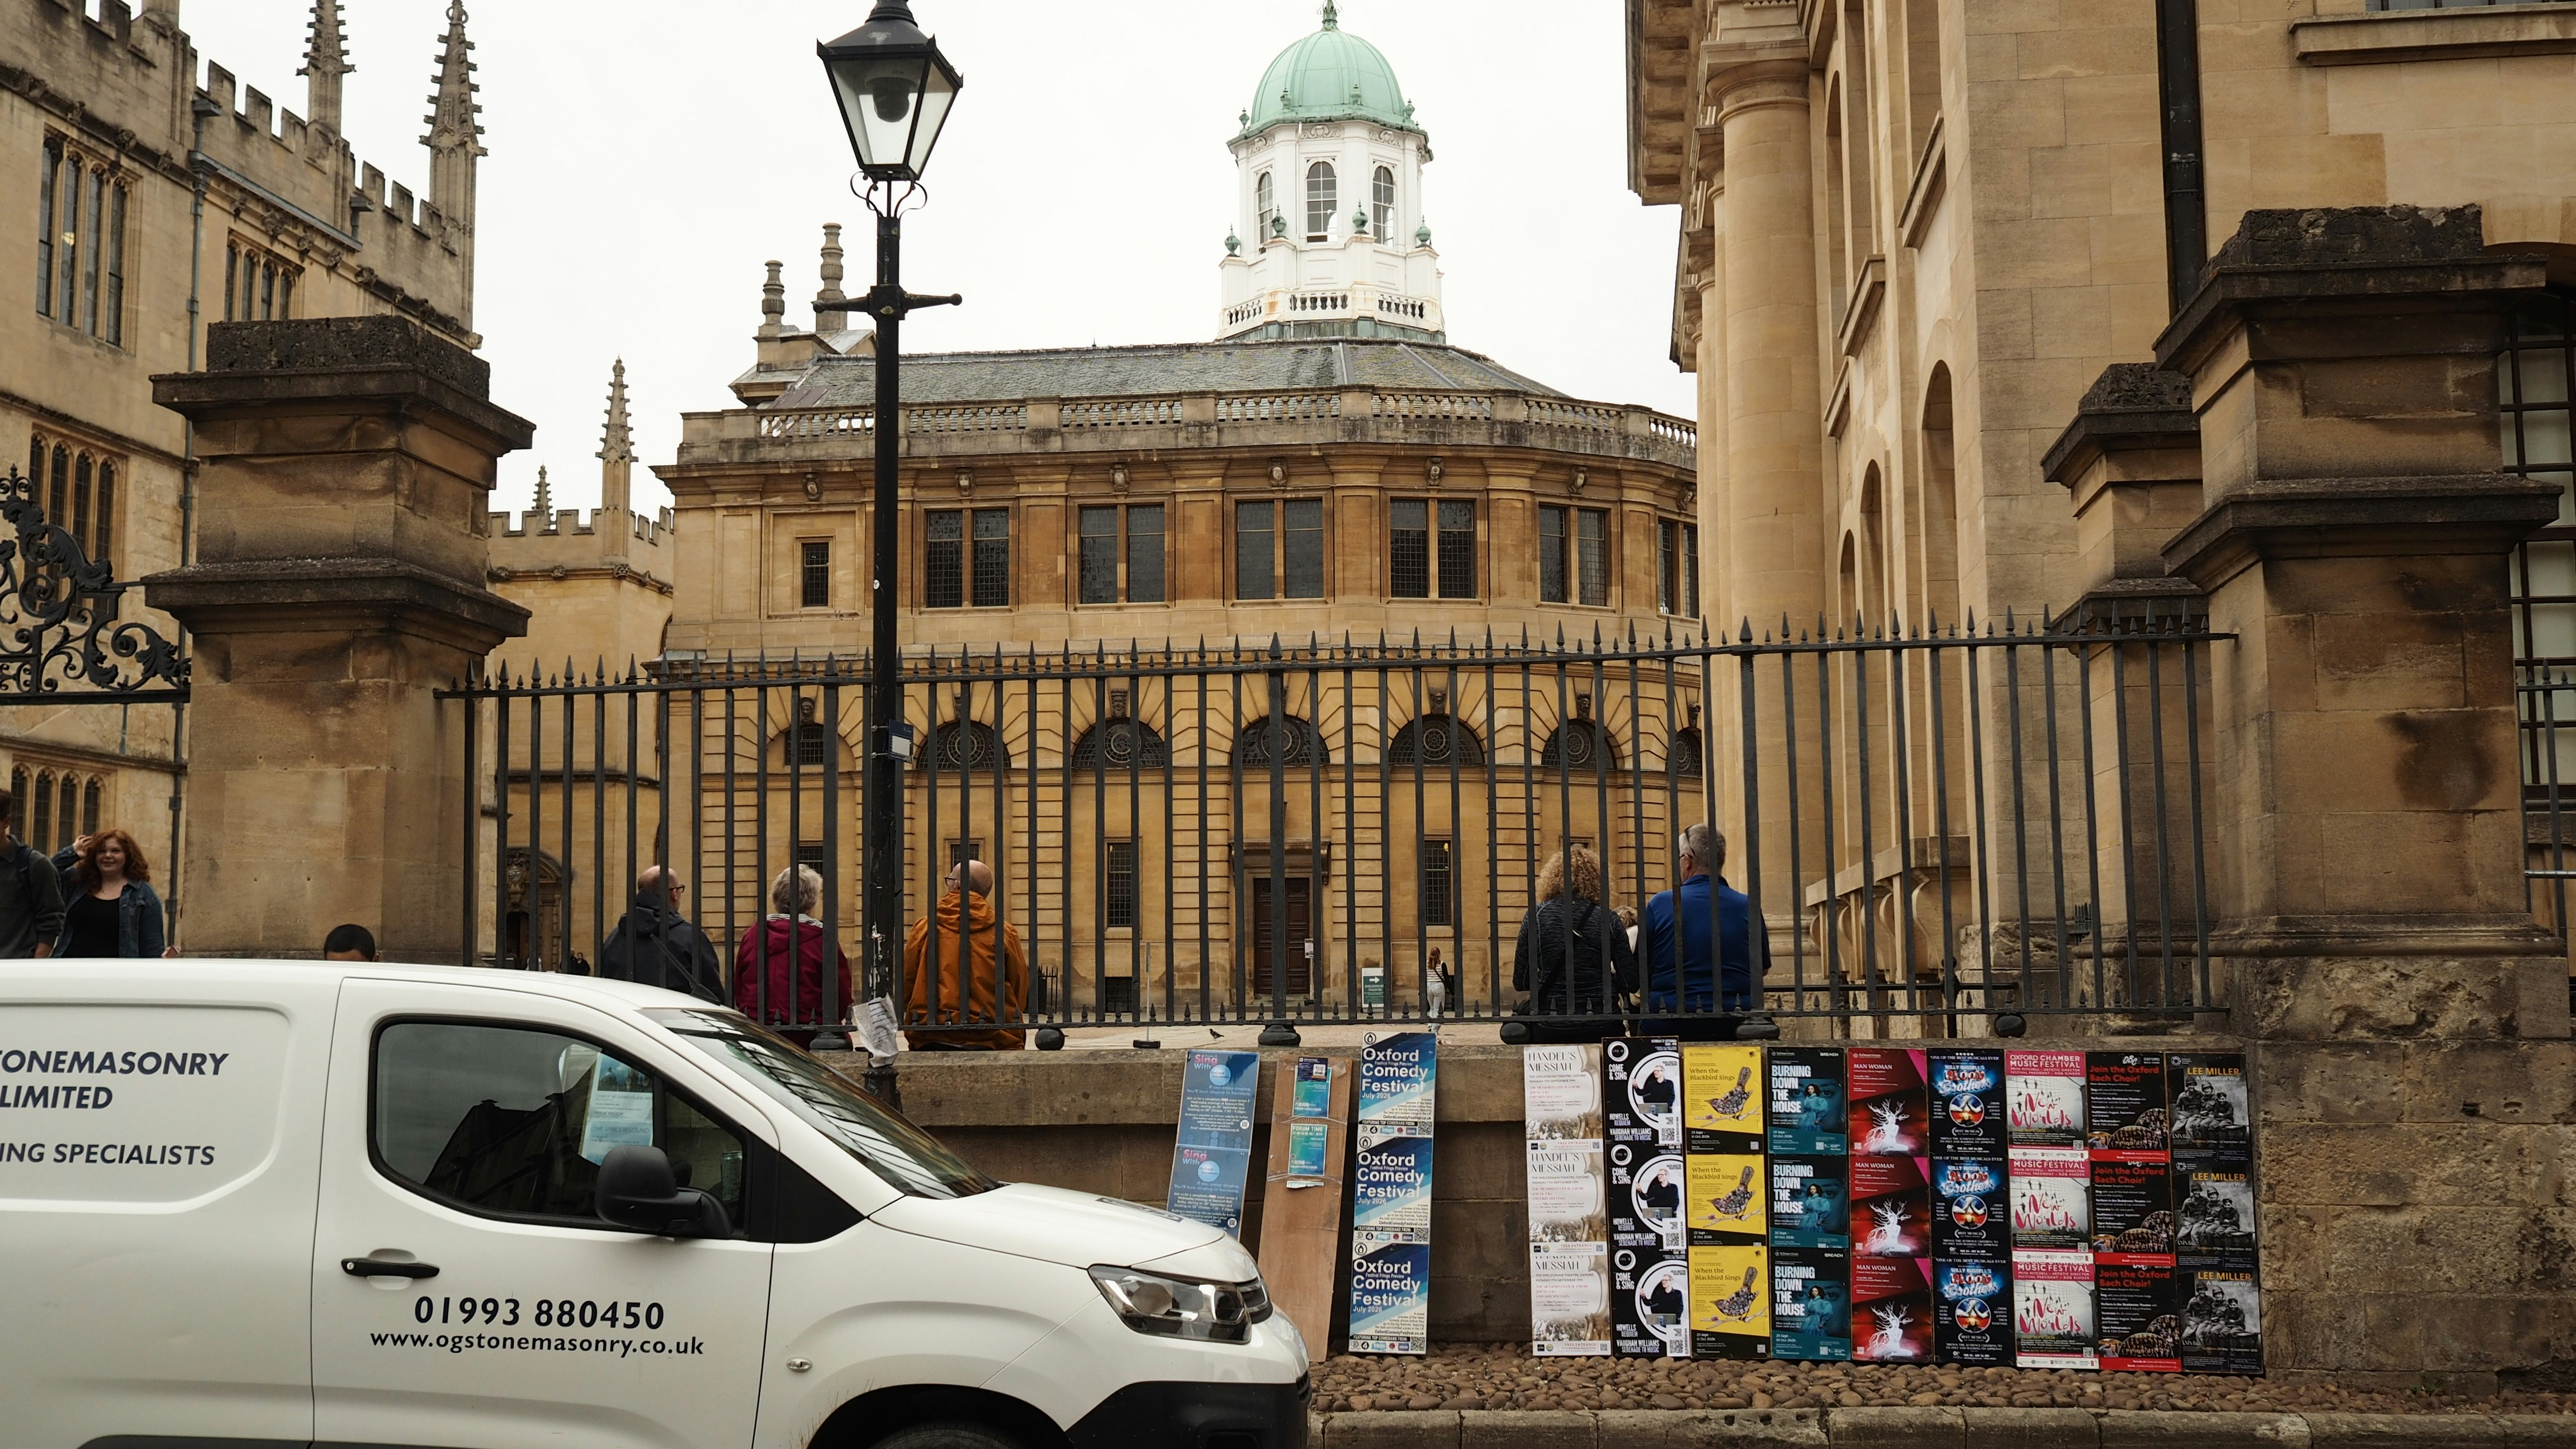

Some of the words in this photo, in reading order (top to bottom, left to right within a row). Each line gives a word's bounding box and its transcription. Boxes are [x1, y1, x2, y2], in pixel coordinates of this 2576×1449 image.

[1195, 1054, 1218, 1066] Sing
[1363, 1048, 1419, 1062] Oxford
[1528, 1052, 1576, 1060] HANDEL'S
[0, 1050, 229, 1076] ONEMASONRY
[1529, 1063, 1571, 1072] MESSIAH
[1609, 1064, 1623, 1072] COME
[1362, 1063, 1428, 1080] Comedy
[1772, 1066, 1811, 1077] BURNING
[1945, 1070, 1986, 1081] BLOOD
[1362, 1079, 1424, 1092] Festival
[1772, 1077, 1798, 1089] DOWN
[1938, 1078, 1992, 1096] Brothers
[0, 1085, 112, 1109] LIMITED
[1772, 1089, 1789, 1100] THE
[1772, 1101, 1801, 1112] HOUSE
[2025, 1092, 2057, 1112] New
[2011, 1107, 2072, 1127] Worlds
[53, 1144, 215, 1165] SPECIALISTS
[1183, 1149, 1207, 1161] Sing
[1358, 1152, 1415, 1166] Oxford
[1532, 1164, 1574, 1172] MESSIAH
[1612, 1167, 1627, 1176] COME
[1773, 1164, 1813, 1177] BURNING
[1357, 1168, 1424, 1186] Comedy
[1618, 1176, 1631, 1184] SING
[1774, 1177, 1800, 1189] DOWN
[1948, 1171, 1988, 1182] BLOOD
[1357, 1183, 1420, 1197] Festival
[1774, 1189, 1790, 1201] THE
[1941, 1180, 1995, 1197] Brothers
[1774, 1201, 1803, 1213] HOUSE
[2029, 1194, 2062, 1214] New
[2015, 1209, 2076, 1229] Worlds
[1353, 1259, 1411, 1273] Oxford
[1536, 1261, 1579, 1270] MESSIAH
[1775, 1266, 1815, 1278] BURNING
[1616, 1272, 1631, 1281] COME
[1951, 1273, 1992, 1285] BLOOD
[1353, 1275, 1420, 1294] Comedy
[1616, 1281, 1621, 1290] &
[1621, 1281, 1635, 1290] SING
[1775, 1278, 1802, 1291] DOWN
[1775, 1291, 1792, 1303] THE
[1944, 1283, 1999, 1300] Brothers
[1353, 1292, 1416, 1306] Festival
[415, 1296, 520, 1325] 01993
[534, 1299, 664, 1329] 880450
[1775, 1303, 1805, 1316] HOUSE
[2033, 1297, 2067, 1318] New
[2019, 1313, 2081, 1334] Worlds
[370, 1332, 704, 1358] www.ogstonemasonry.co.uk
